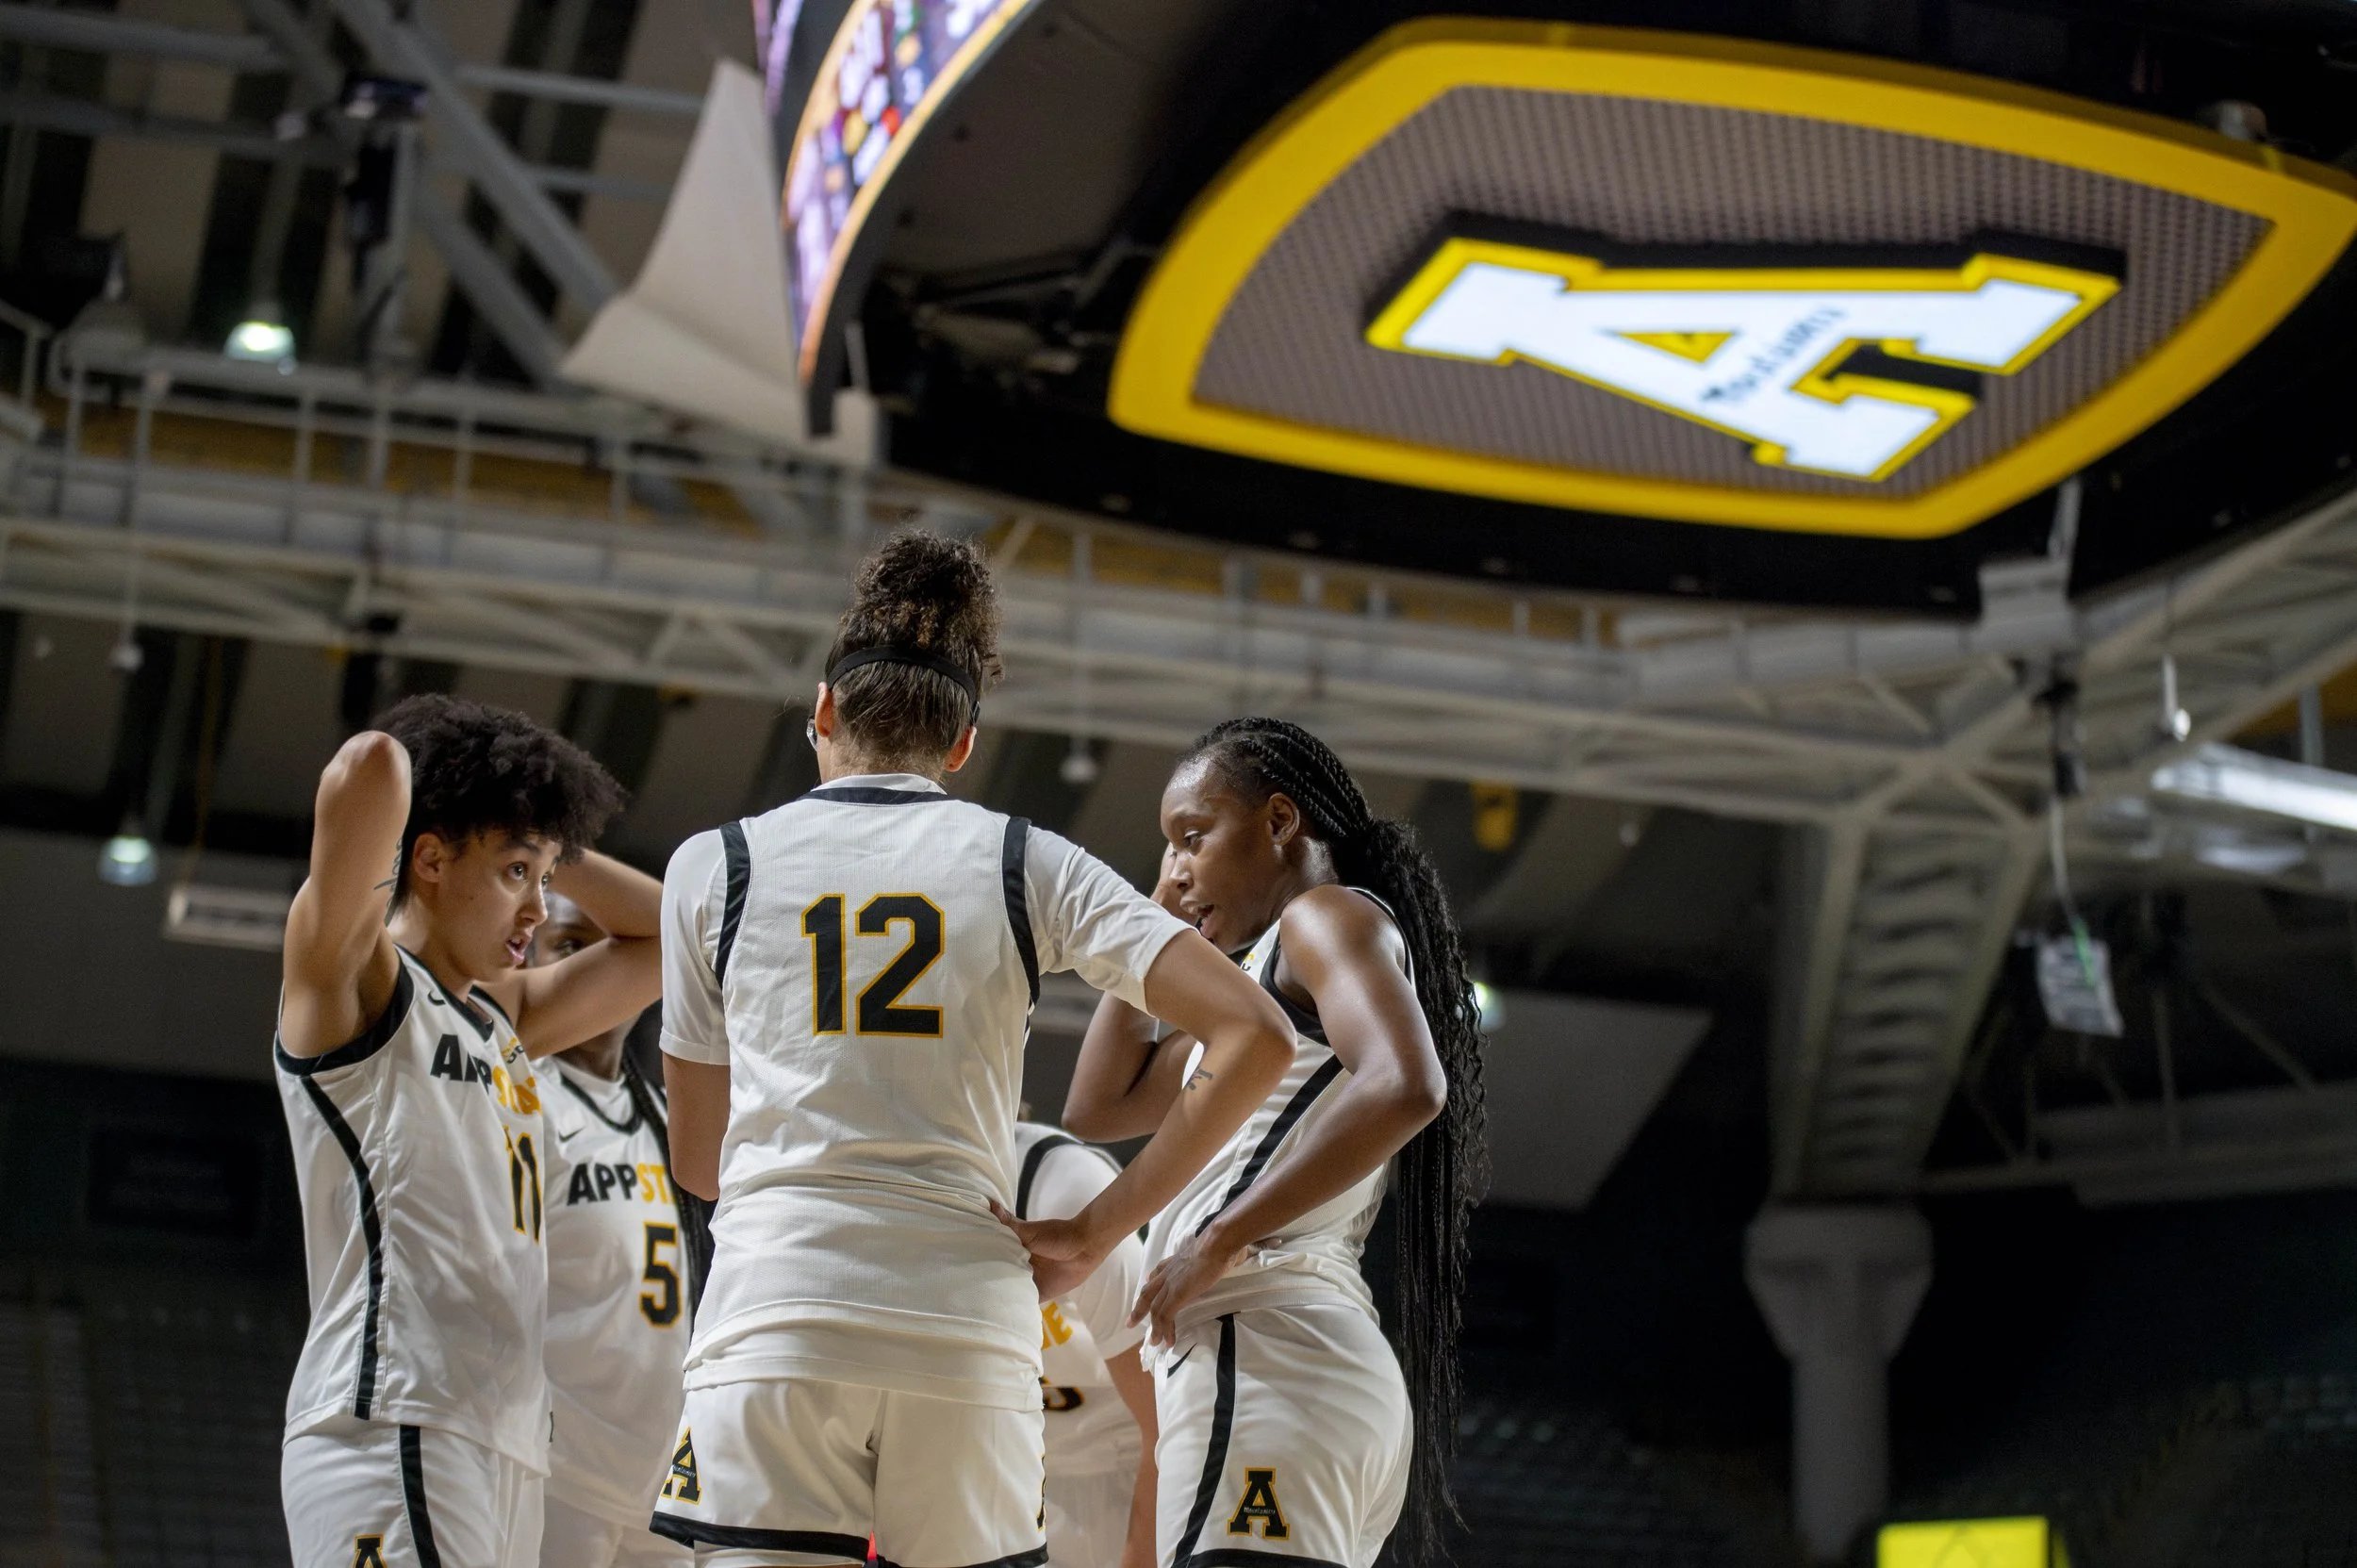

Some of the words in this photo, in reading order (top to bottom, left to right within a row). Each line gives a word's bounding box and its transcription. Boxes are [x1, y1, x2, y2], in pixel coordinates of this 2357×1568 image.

[1366, 238, 2121, 481] A
[801, 893, 944, 1037] 12
[503, 1125, 542, 1246] 11
[567, 1163, 675, 1206] APPST
[639, 1222, 683, 1328] 5
[1227, 1467, 1290, 1541] A
